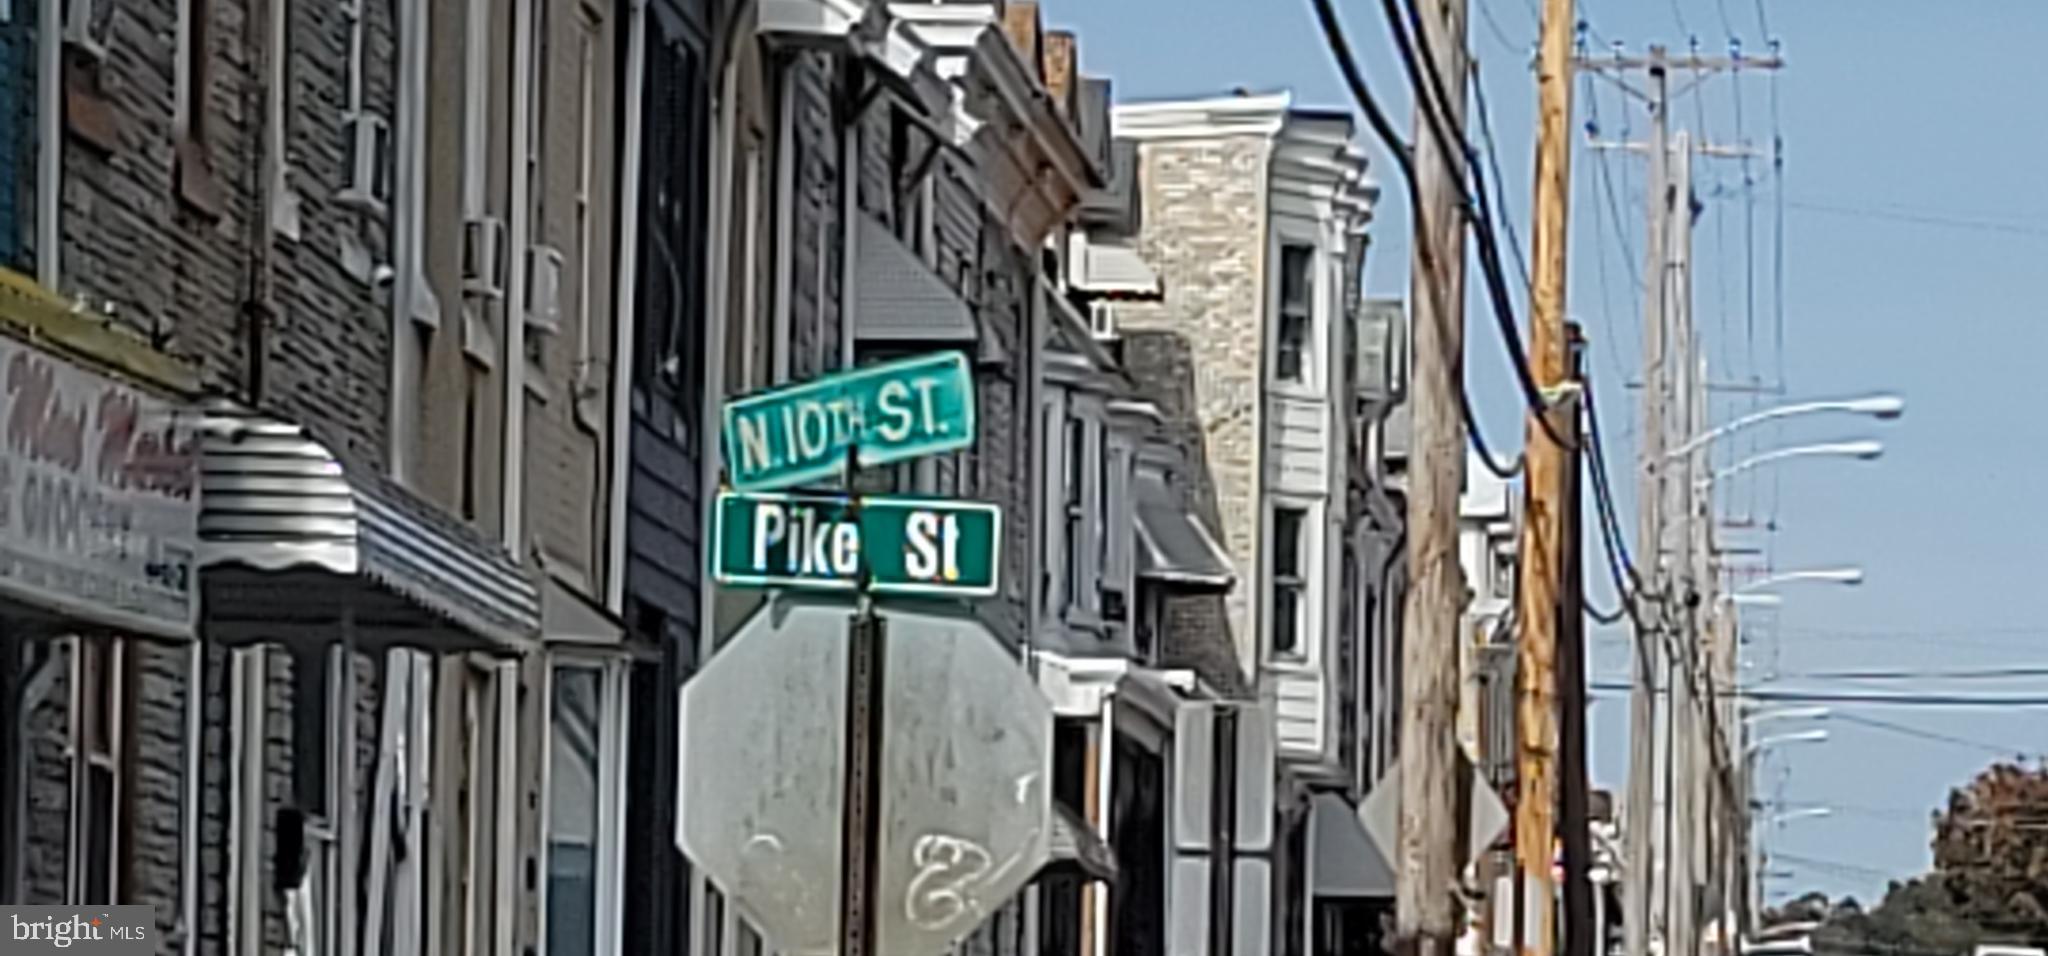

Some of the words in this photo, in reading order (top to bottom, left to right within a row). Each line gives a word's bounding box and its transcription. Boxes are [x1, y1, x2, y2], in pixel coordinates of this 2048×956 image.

[876, 375, 950, 442] ST.
[753, 502, 859, 576] Pike
[905, 511, 960, 581] St
